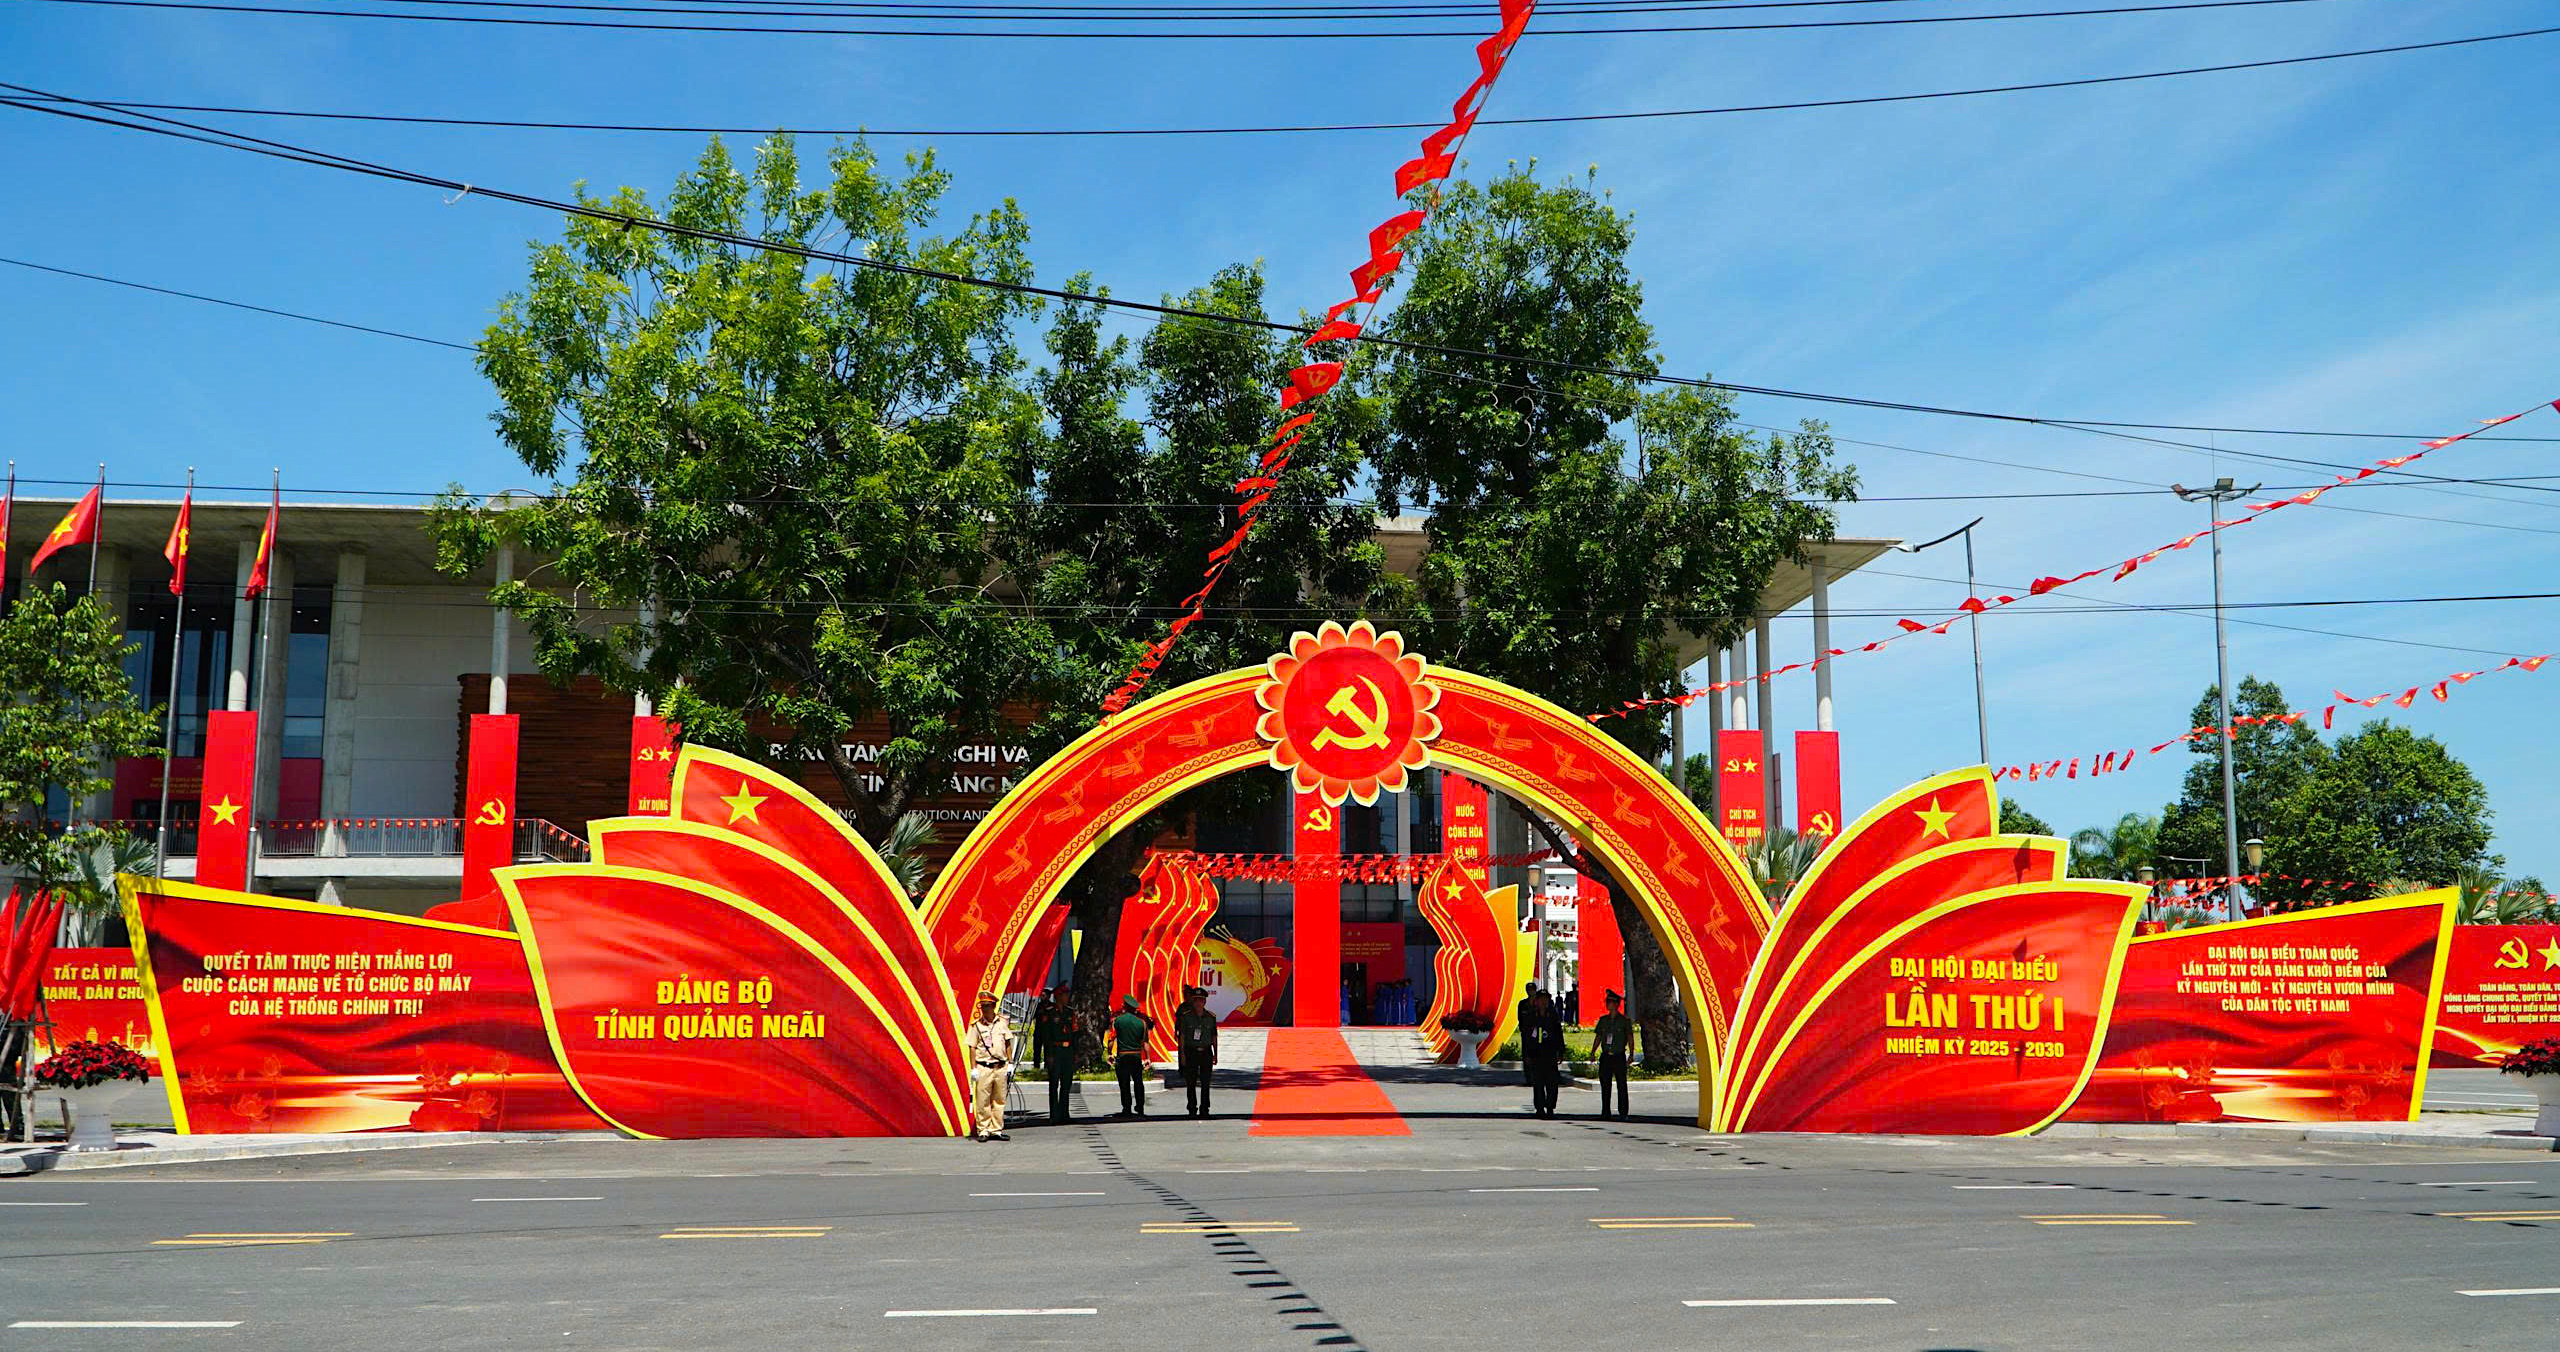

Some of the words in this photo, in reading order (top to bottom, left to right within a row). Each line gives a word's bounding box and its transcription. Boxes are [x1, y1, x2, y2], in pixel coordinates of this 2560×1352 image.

[1456, 803, 1475, 817] NƯỚC
[1448, 825, 1467, 840] CỘNG
[1469, 824, 1483, 838] HÒA
[203, 950, 251, 972] QUYẾT
[255, 951, 287, 970] TÂM
[292, 953, 330, 973] THỰC
[335, 951, 370, 973] HIỆN
[375, 949, 424, 970] THẮNG
[429, 953, 453, 972] LỢI
[2208, 946, 2226, 961] ĐẠI
[2229, 944, 2247, 961] HỘI
[2250, 947, 2268, 961] ĐẠI
[2271, 942, 2296, 959] BIỂU
[2299, 945, 2327, 960] TOÀN
[2330, 944, 2359, 961] QUỐC
[53, 963, 79, 980] TẤT
[81, 963, 100, 980] CẢ
[103, 964, 117, 980] VÌ
[120, 967, 140, 982] MỤ
[1890, 957, 1924, 981] ĐẠI
[1931, 955, 1965, 982] HỘI
[1971, 960, 2005, 984] ĐẠI
[2012, 954, 2058, 981] BIỂU
[2182, 960, 2204, 976] LẦN
[2206, 961, 2227, 976] THỨ
[2229, 964, 2247, 976] XIV
[2250, 959, 2272, 976] CỦA
[2275, 960, 2304, 977] ĐẢNG
[2307, 961, 2332, 977] KHỞI
[2335, 960, 2362, 977] ĐIỂM
[2365, 961, 2387, 977] CỦA
[85, 984, 114, 999] DÂN
[182, 975, 223, 996] CUỘC
[228, 974, 268, 992] CÁCH
[273, 977, 319, 996] MẠNG
[323, 973, 341, 992] VỀ
[346, 971, 365, 992] TỔ
[369, 974, 409, 992] CHỨC
[413, 974, 434, 995] BỘ
[438, 973, 472, 992] MÁY
[656, 973, 729, 1004] ĐẢNG
[738, 976, 773, 1009] BỘ
[2177, 977, 2191, 993] KỶ
[2194, 978, 2238, 993] NGUYÊN
[2240, 979, 2261, 993] MỚI
[2271, 978, 2285, 994] KỶ
[2288, 979, 2332, 994] NGUYÊN
[2334, 981, 2363, 994] VƯƠN
[2366, 980, 2394, 994] MÌNH
[229, 995, 259, 1015] CỦA
[264, 997, 284, 1018] HỆ
[288, 995, 338, 1015] THỐNG
[342, 996, 389, 1015] CHÍNH
[393, 999, 423, 1017] TRỊ!
[1885, 981, 1958, 1028] LẦN
[1969, 989, 2044, 1031] THỨ
[2053, 996, 2064, 1031] I
[2221, 995, 2244, 1011] CỦA
[2246, 996, 2269, 1011] DÂN
[2272, 997, 2292, 1014] TỘC
[2294, 997, 2317, 1015] VIỆT
[2321, 999, 2350, 1012] NAM!
[594, 1008, 655, 1039] TỈNH
[663, 1007, 753, 1041] QUẢNG
[762, 1010, 825, 1038] NGÃI
[1886, 1035, 1939, 1057] NHIỆM
[1945, 1036, 1965, 1055] KỲ
[1969, 1040, 2009, 1056] 2025
[2024, 1042, 2064, 1057] 2030
